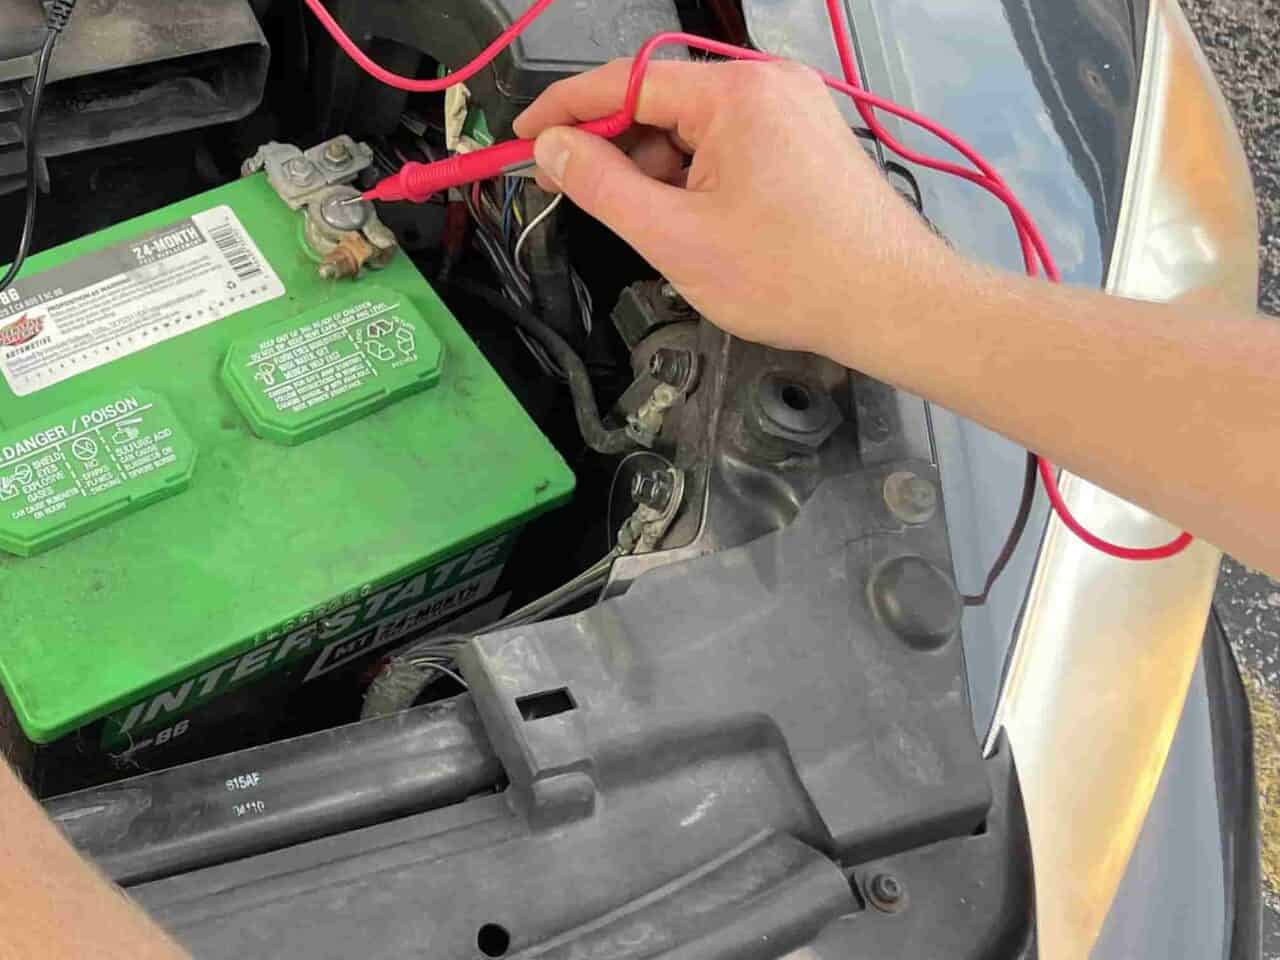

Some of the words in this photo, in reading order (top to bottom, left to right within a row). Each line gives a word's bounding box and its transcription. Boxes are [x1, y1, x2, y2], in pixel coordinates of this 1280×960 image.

[132, 226, 201, 259] 24-MONTH
[2, 424, 67, 460] DANGER
[81, 395, 138, 428] POISON
[119, 545, 502, 734] INTERSTATE
